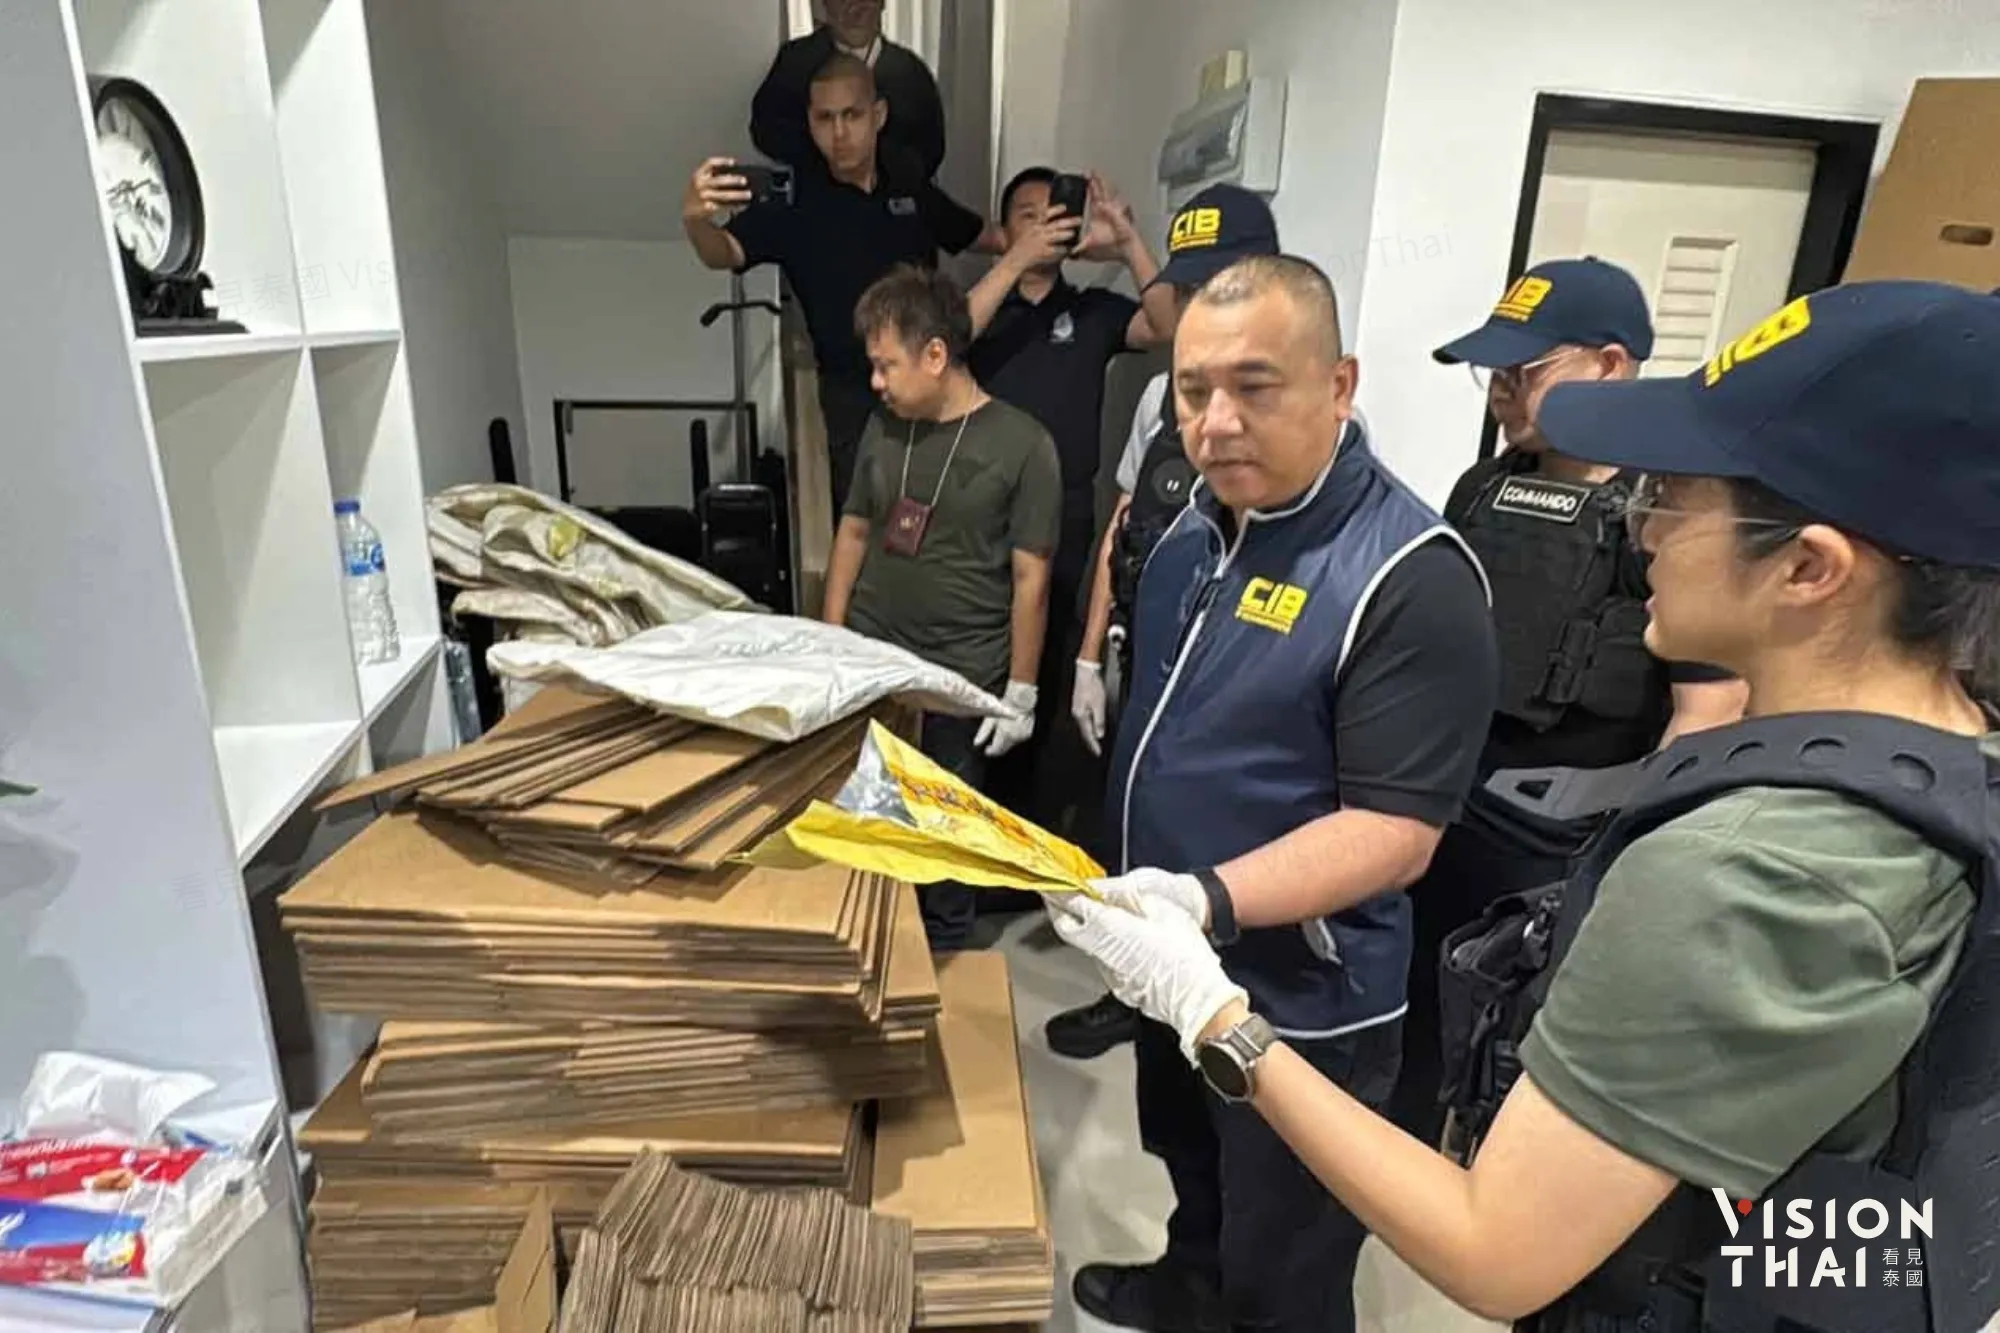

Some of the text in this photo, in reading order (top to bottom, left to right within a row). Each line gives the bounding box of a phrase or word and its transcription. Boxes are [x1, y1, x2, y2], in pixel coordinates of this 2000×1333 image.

[1172, 208, 1221, 240] CIB
[1503, 485, 1577, 512] COMMANDO
[1241, 576, 1308, 621] CIB
